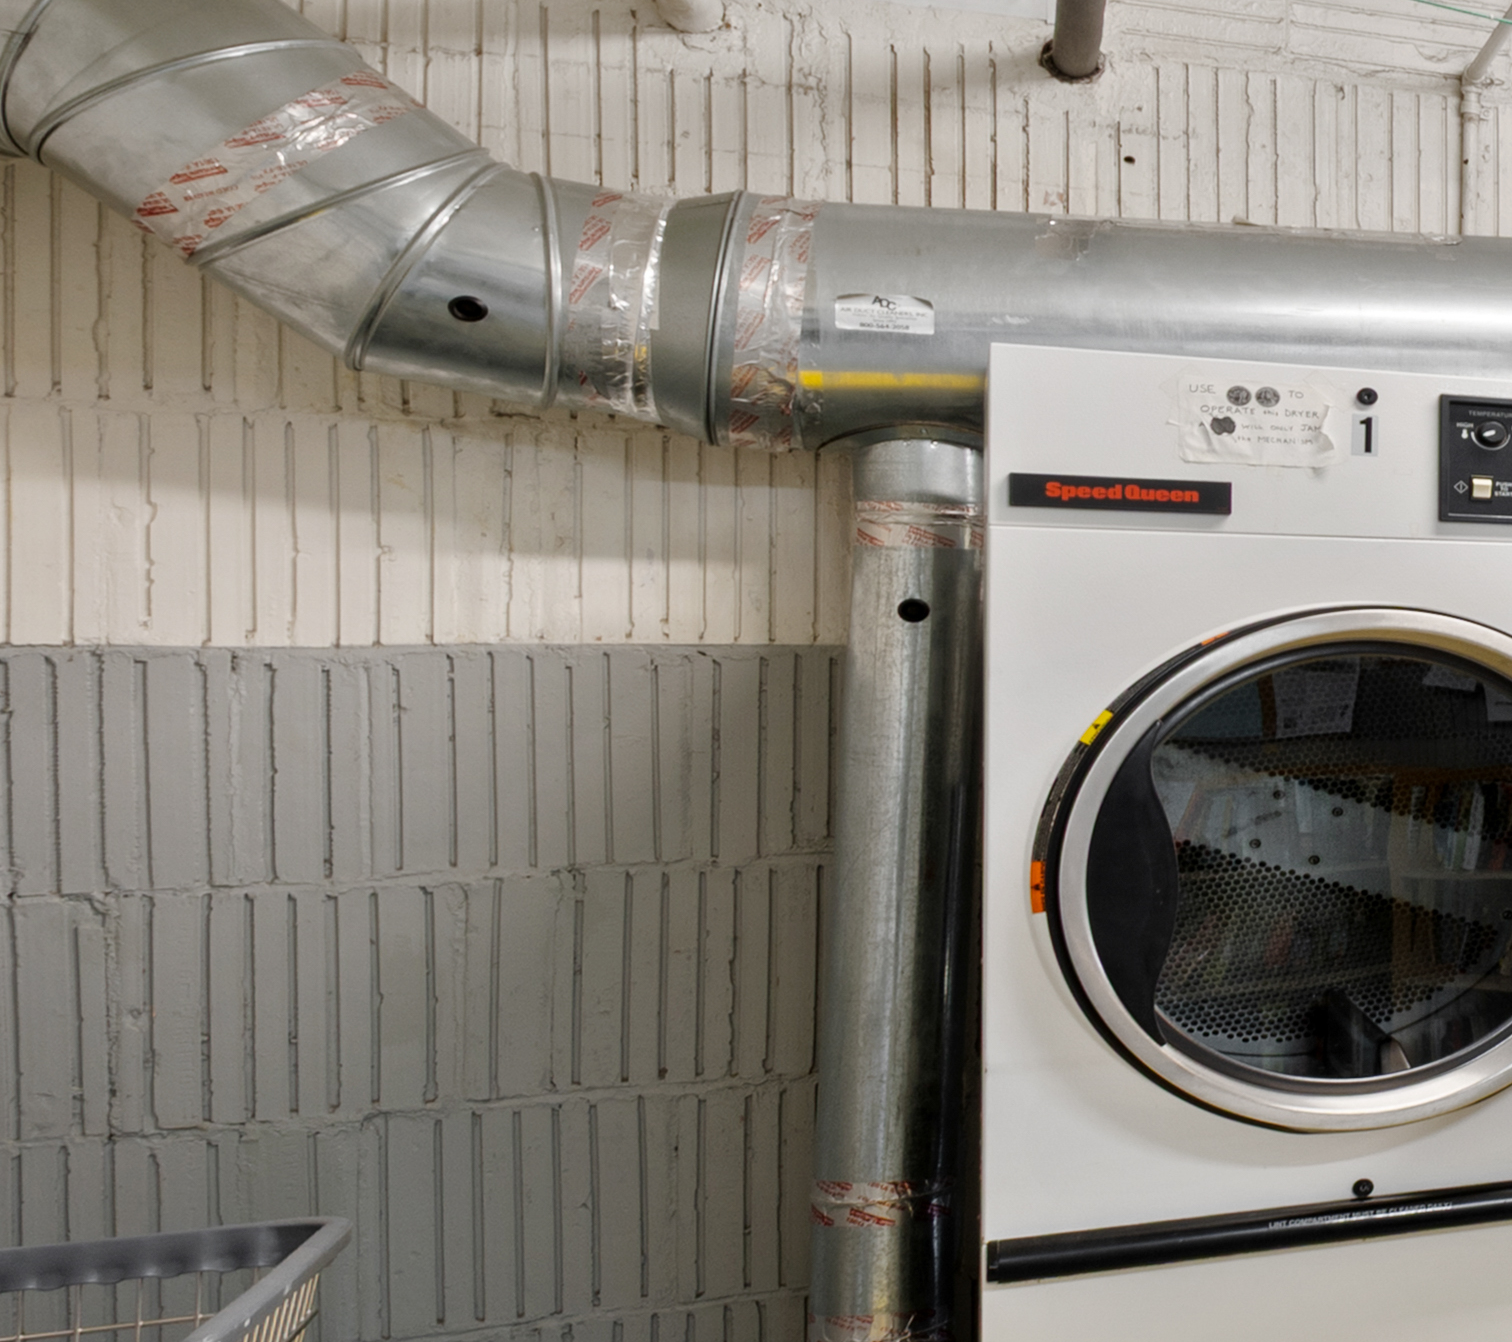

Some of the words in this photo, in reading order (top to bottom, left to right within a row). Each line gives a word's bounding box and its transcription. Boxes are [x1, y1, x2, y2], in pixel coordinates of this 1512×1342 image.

[1188, 383, 1216, 395] USE
[1288, 390, 1305, 399] TO
[1199, 404, 1256, 416] OPERATE
[1284, 409, 1320, 420] DRYER
[1300, 424, 1323, 433] JAM
[1359, 417, 1373, 453] 1
[1045, 481, 1122, 501] Speed
[1124, 484, 1199, 503] Queen
[1268, 1221, 1288, 1230] LINT
[1289, 1214, 1350, 1227] COMPARTMENT
[1352, 1210, 1374, 1219] MUST
[1389, 1204, 1426, 1215] CLEANED
